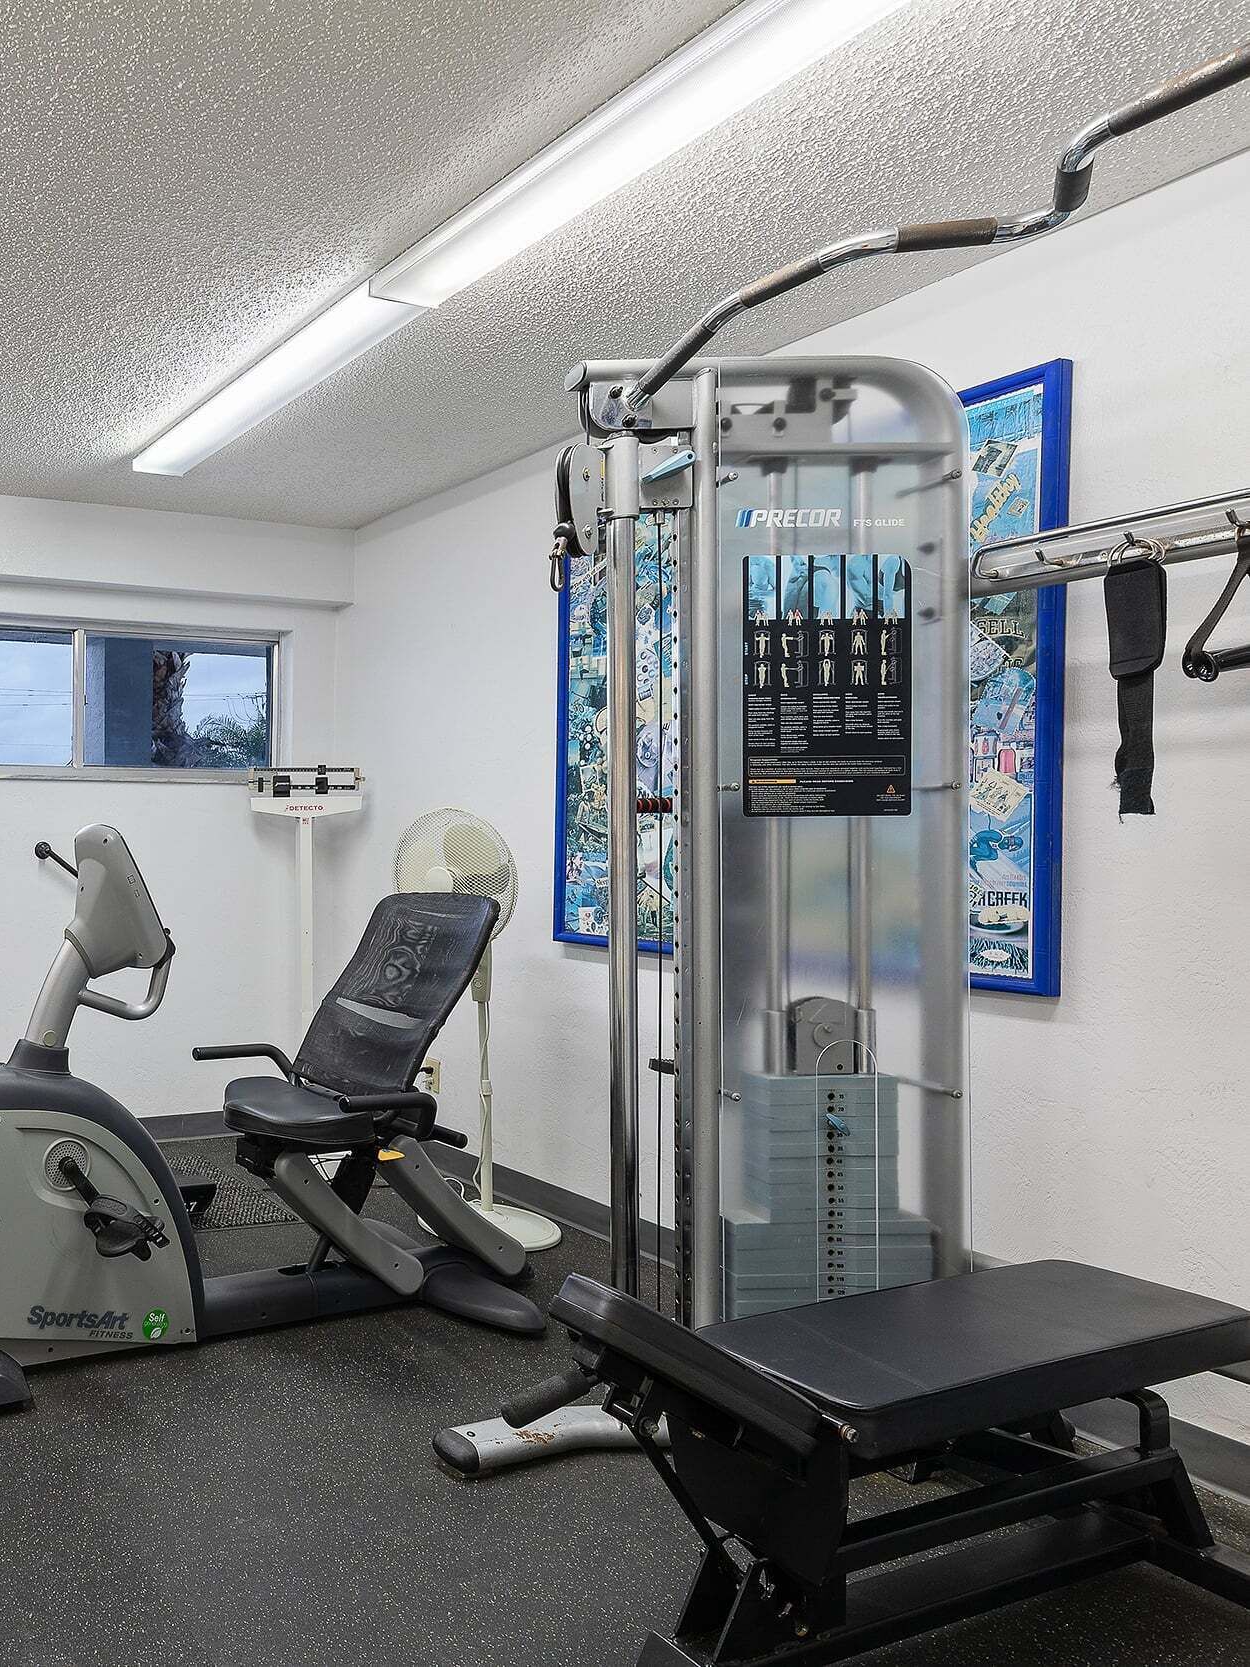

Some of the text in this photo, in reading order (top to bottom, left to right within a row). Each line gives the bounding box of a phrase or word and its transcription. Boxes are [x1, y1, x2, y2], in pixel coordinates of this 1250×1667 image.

[751, 508, 842, 528] PRECOR
[874, 518, 906, 527] GLIDE
[27, 1305, 130, 1330] SportsArt
[148, 1312, 166, 1323] Self
[89, 1330, 134, 1339] FITNESS
